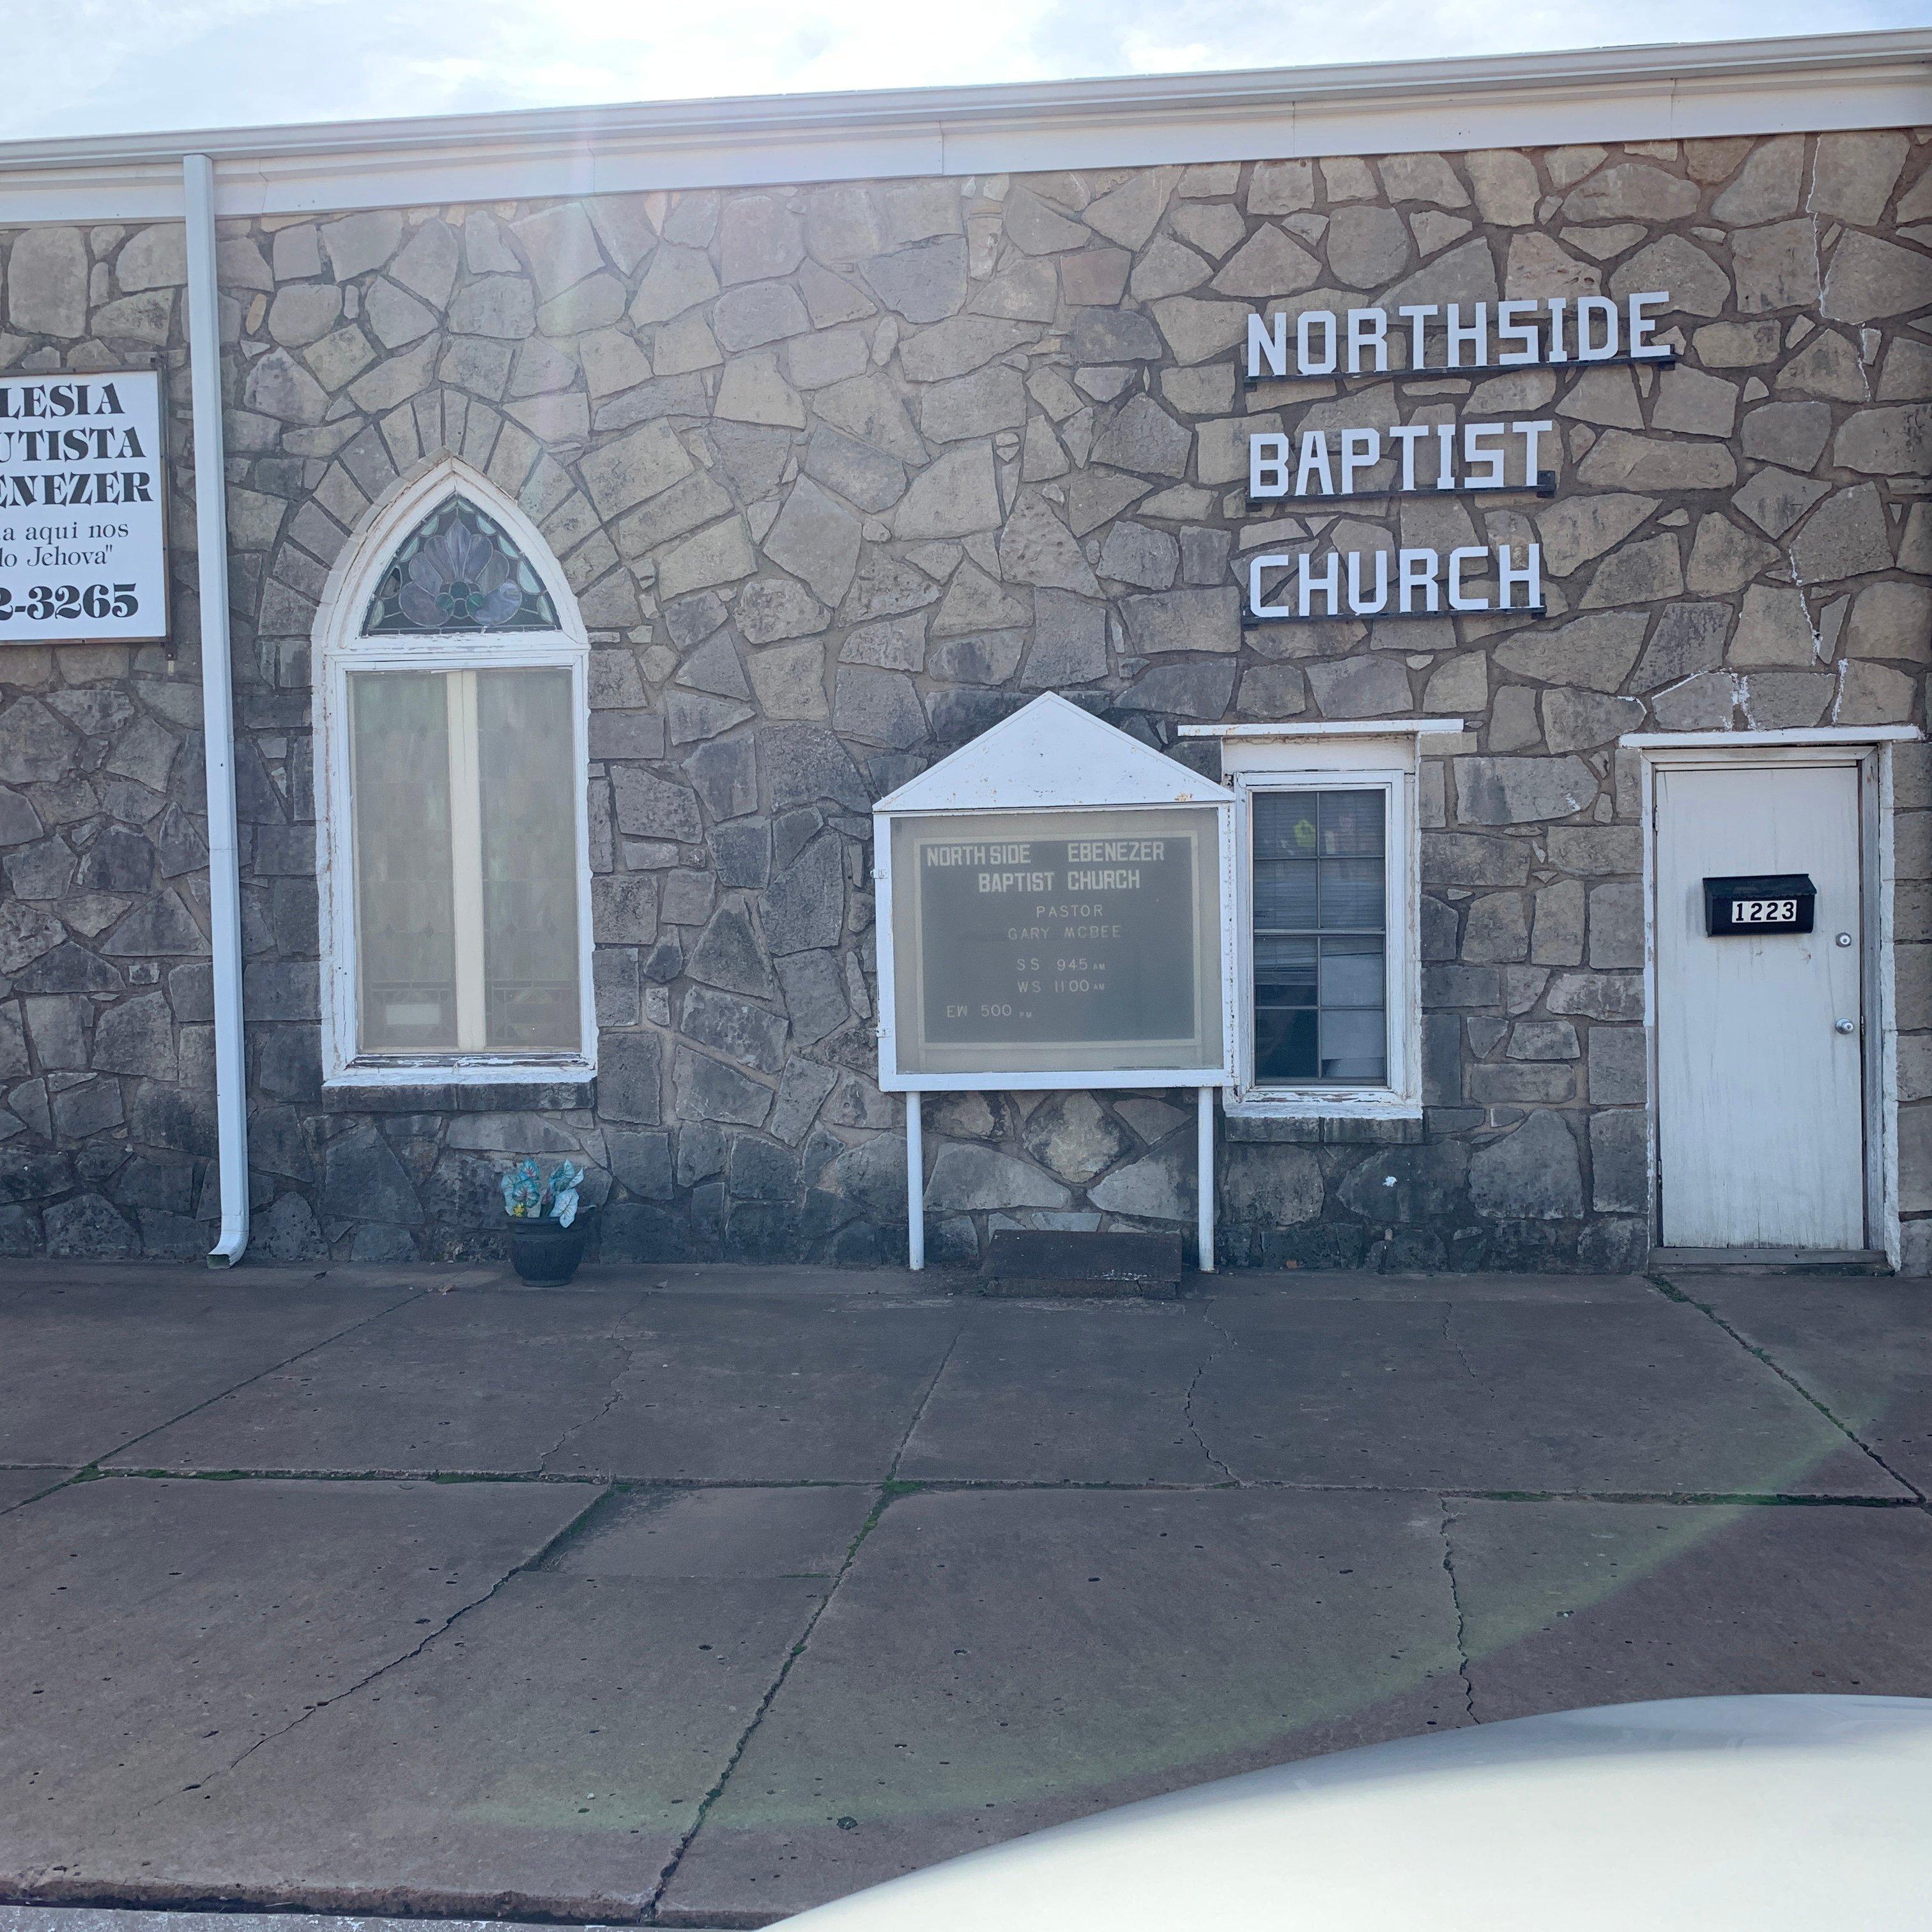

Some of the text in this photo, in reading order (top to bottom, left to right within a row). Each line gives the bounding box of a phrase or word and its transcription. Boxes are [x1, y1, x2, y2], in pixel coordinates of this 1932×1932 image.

[1248, 291, 1670, 377] NORTHSIDE
[0, 383, 125, 420] LESIA
[1250, 420, 1552, 497] BAPTIST
[25, 521, 79, 544] aqui
[88, 523, 128, 538] nos
[1250, 544, 1540, 617] CHURCH
[1068, 841, 1165, 862] EBENEZER
[978, 869, 1140, 893] BAPTIST CHURCH
[1036, 904, 1103, 918] PASTOR
[1735, 901, 1795, 921] 1223
[1008, 926, 1050, 940] GARY
[1057, 958, 1088, 971] 945
[981, 1004, 1012, 1017] 500
